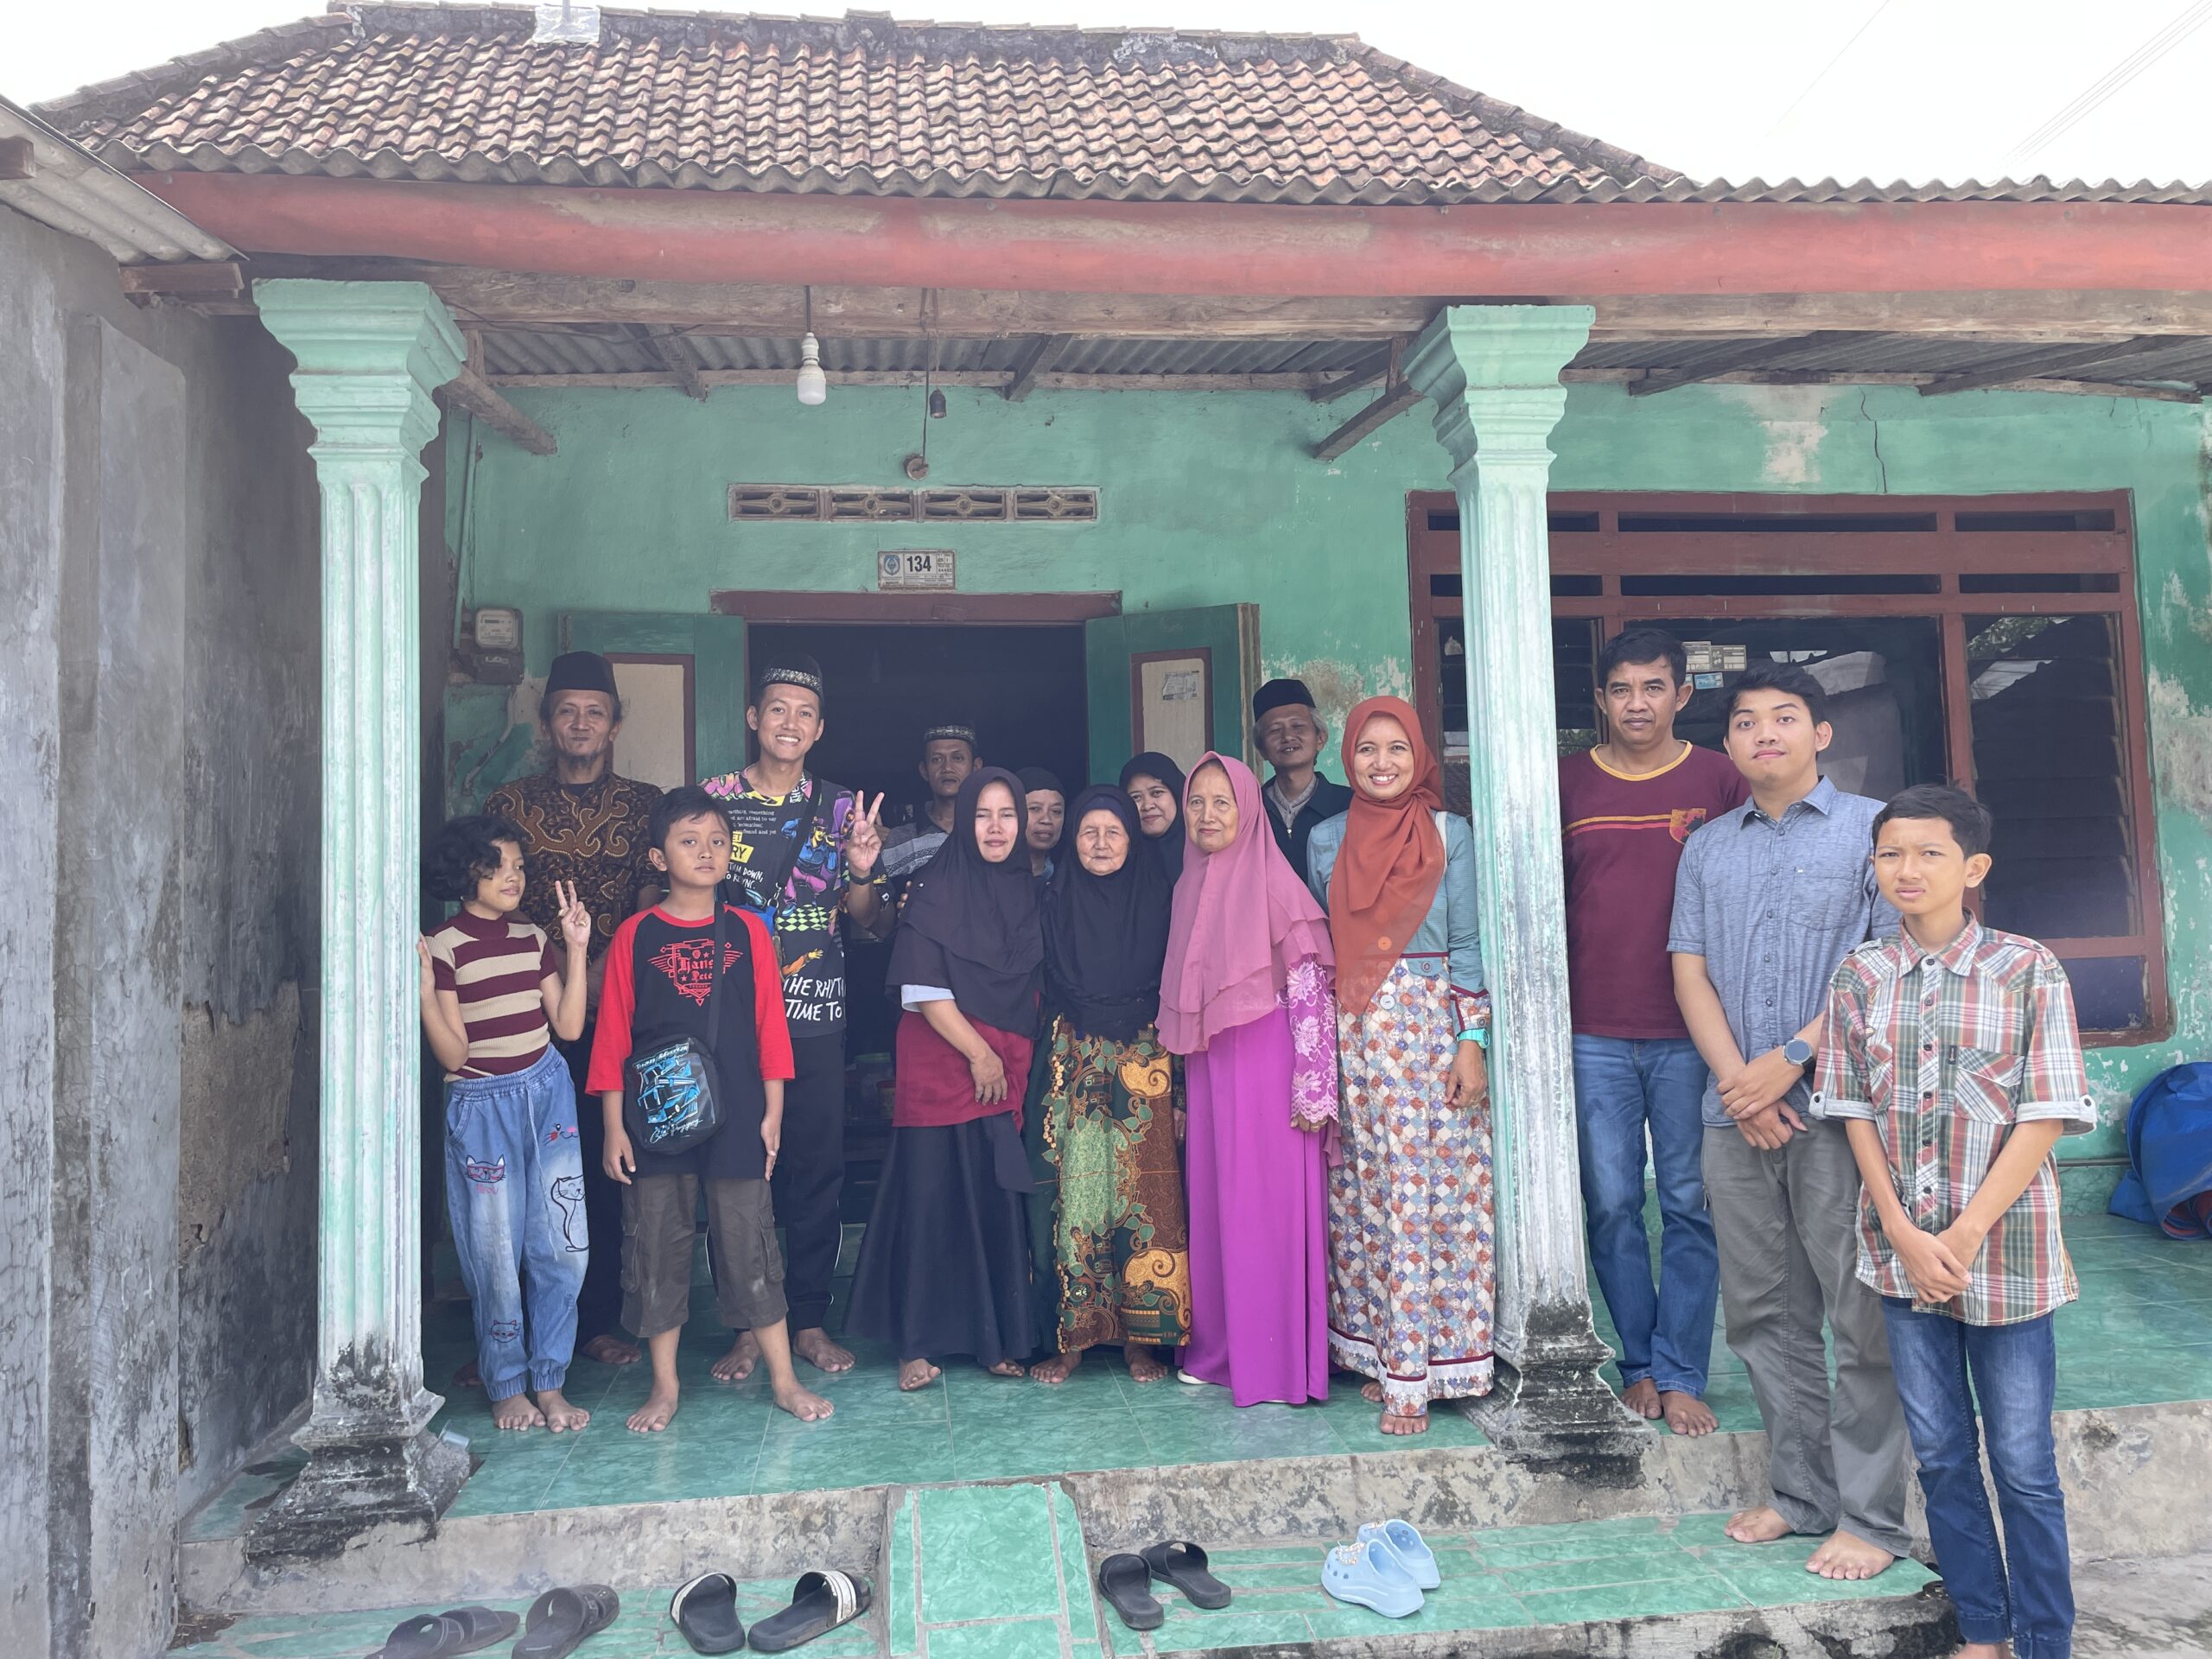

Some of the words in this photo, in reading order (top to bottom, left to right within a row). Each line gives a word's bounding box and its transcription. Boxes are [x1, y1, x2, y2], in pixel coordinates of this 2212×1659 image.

[906, 556, 931, 572] 134
[743, 867, 763, 883] DOWN,
[691, 970, 713, 983] Pete
[785, 999, 823, 1021] TIME
[825, 1001, 842, 1021] TO
